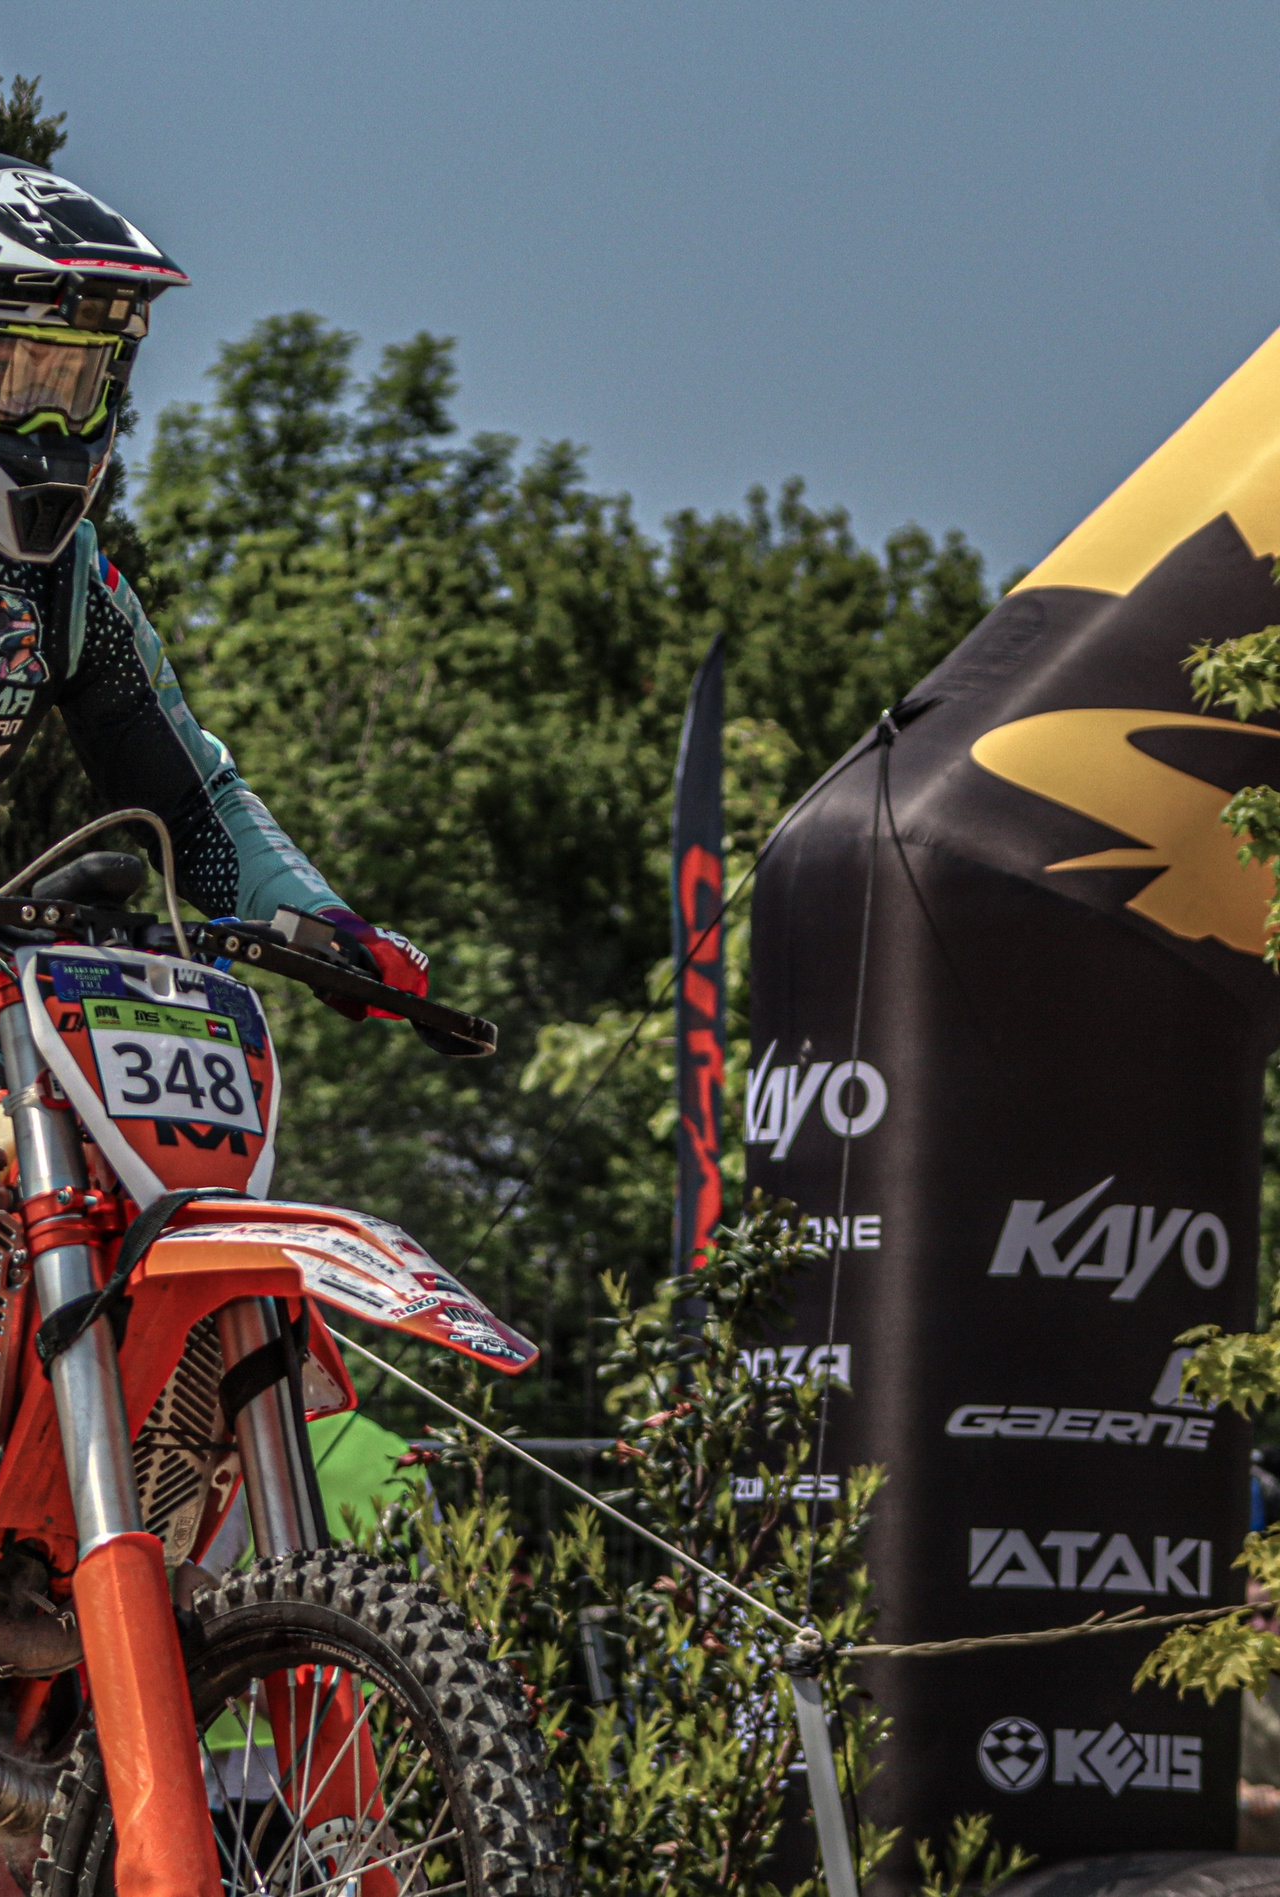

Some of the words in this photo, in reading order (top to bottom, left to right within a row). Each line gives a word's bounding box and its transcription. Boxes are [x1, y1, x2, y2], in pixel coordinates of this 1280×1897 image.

[112, 1041, 244, 1116] 348
[988, 1176, 1228, 1301] KAYO
[945, 1404, 1215, 1451] GAERNE
